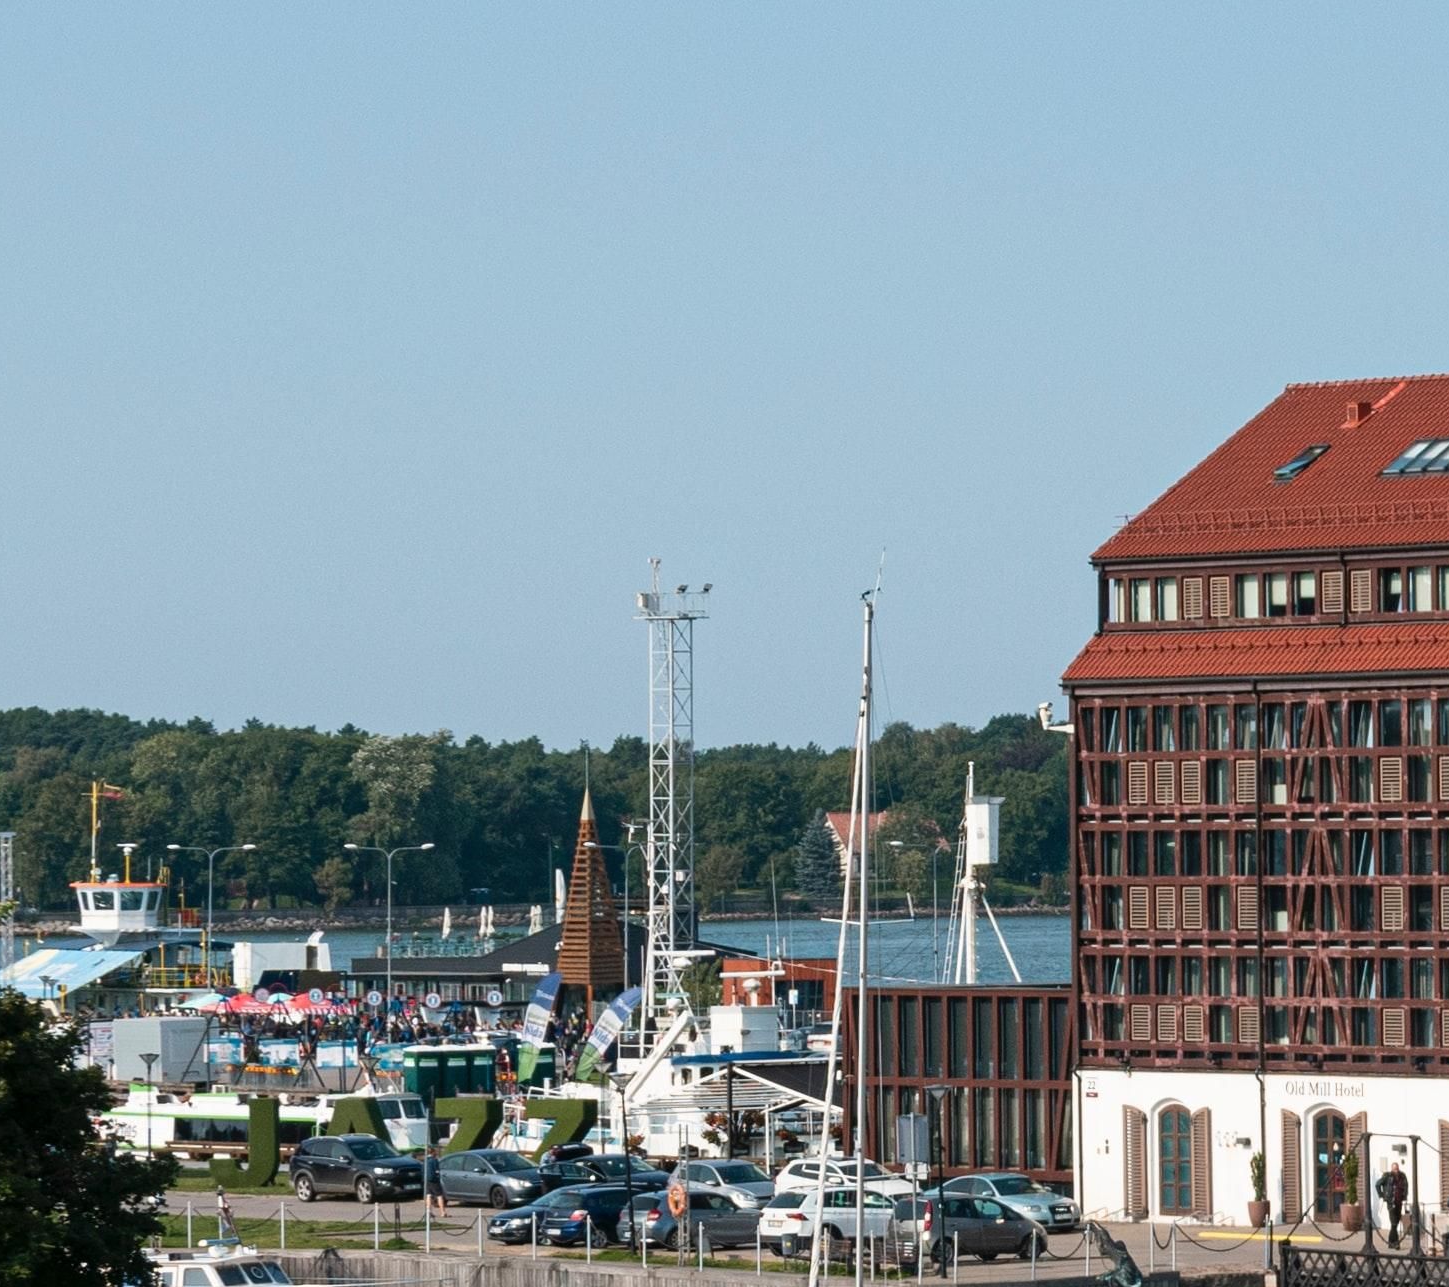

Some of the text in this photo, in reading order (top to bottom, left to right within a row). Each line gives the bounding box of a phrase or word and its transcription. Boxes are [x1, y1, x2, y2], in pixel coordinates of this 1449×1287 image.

[1087, 1080, 1096, 1090] 22
[1285, 1080, 1364, 1098] Old Mill Hotel
